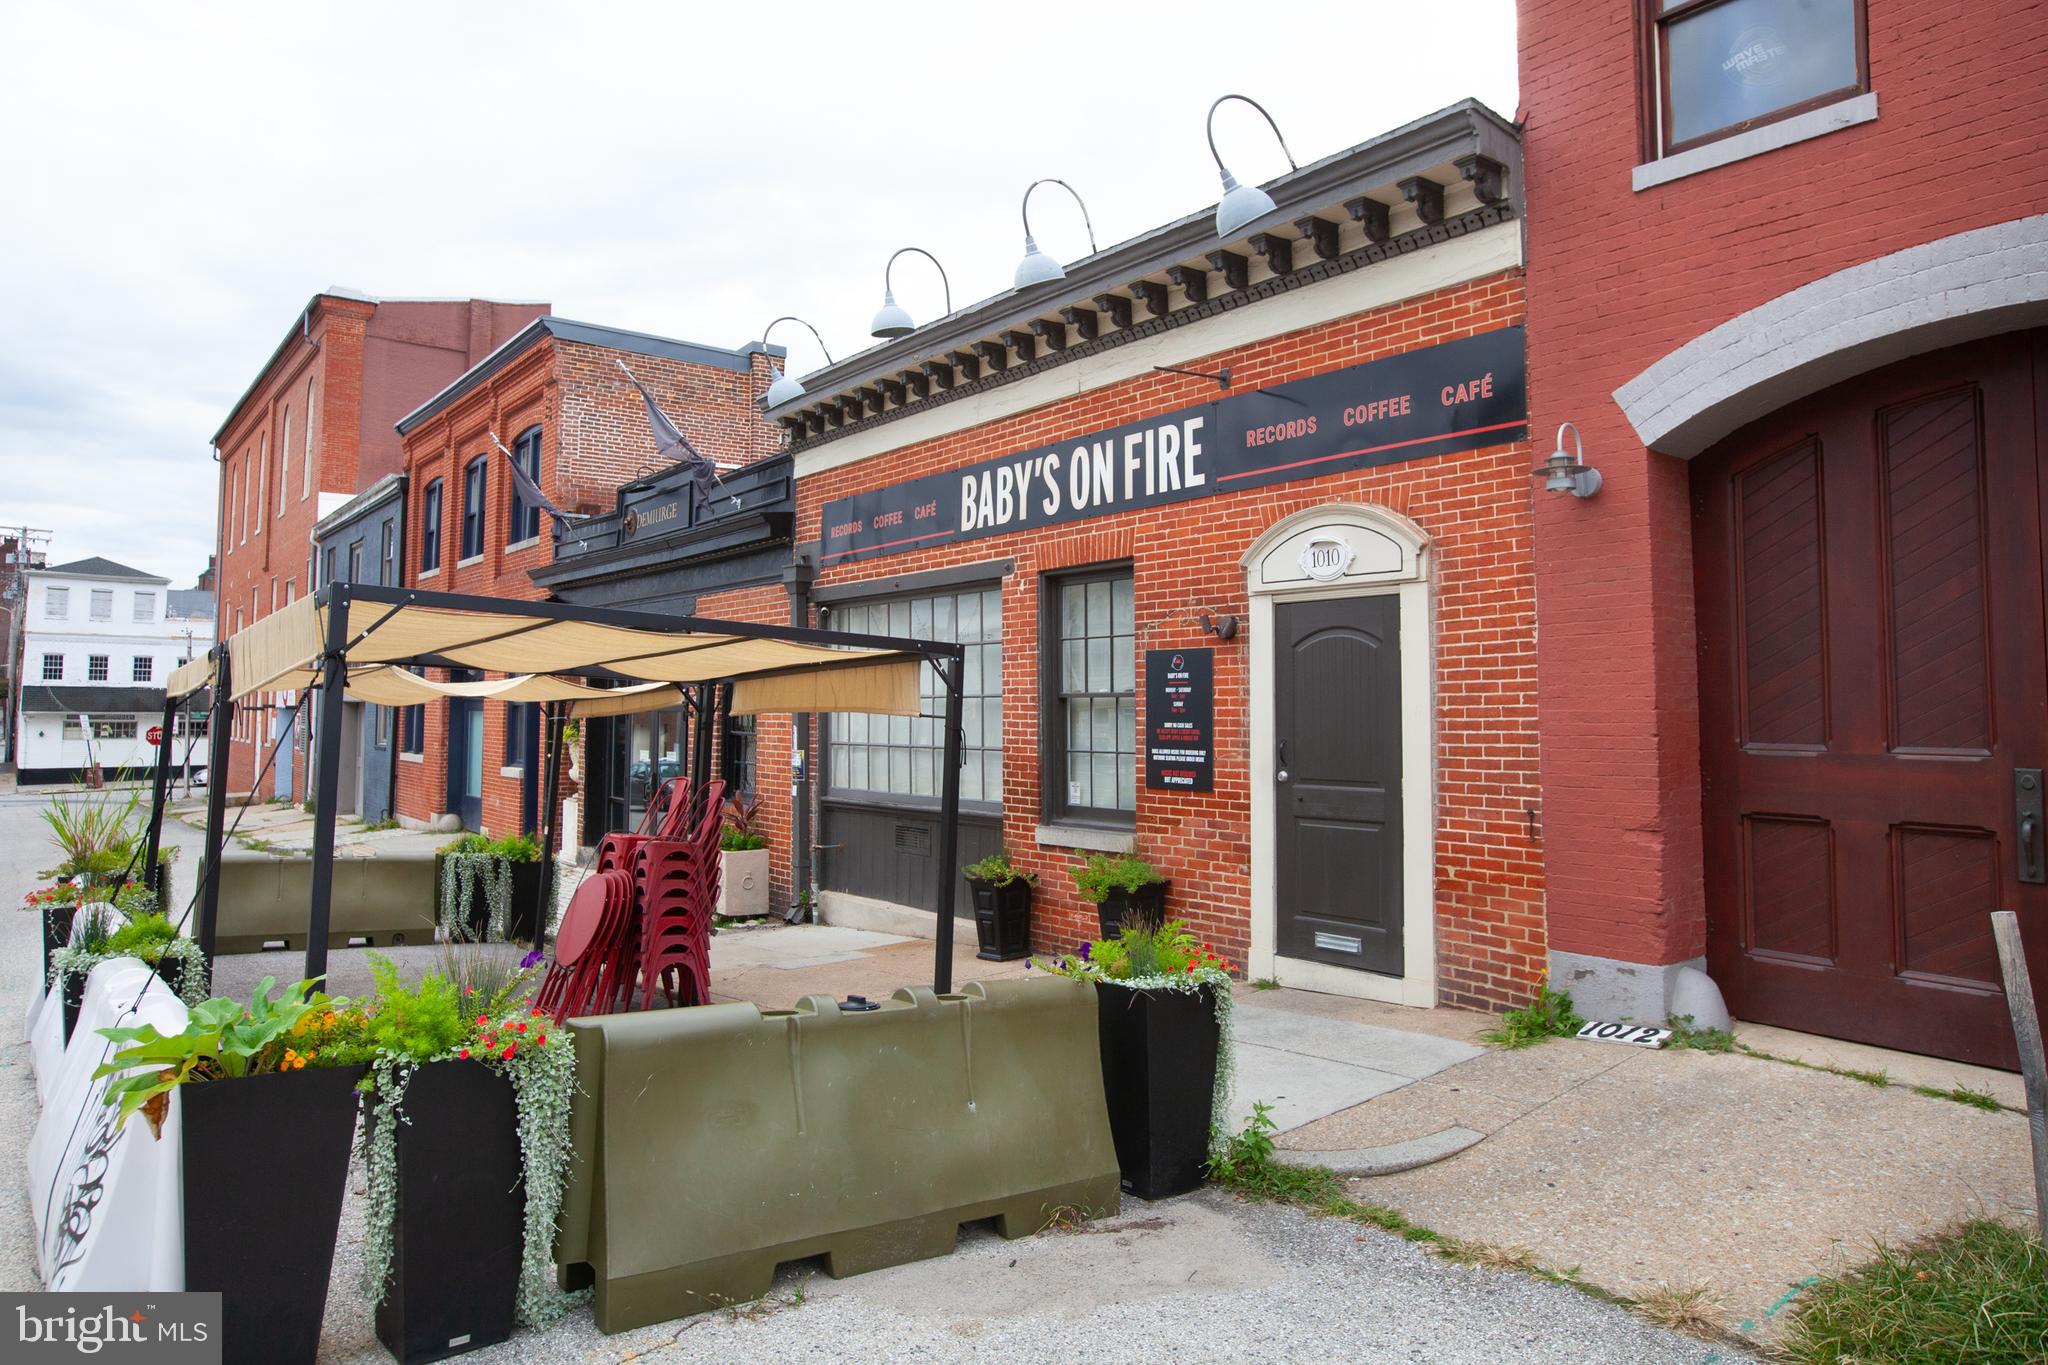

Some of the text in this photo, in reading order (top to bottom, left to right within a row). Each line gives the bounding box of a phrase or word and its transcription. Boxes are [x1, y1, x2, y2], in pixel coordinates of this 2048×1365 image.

[1722, 43, 1761, 70] WAVE
[1246, 372, 1493, 448] RECORDS COFFEE CAFÉ
[960, 416, 1206, 532] BABY'S ON FIRE
[636, 502, 678, 529] DEMIURGE
[830, 500, 937, 539] RECORDS COFFEE CAFÉ
[1311, 548, 1340, 568] 1010
[147, 730, 162, 740] STO
[1580, 1021, 1660, 1043] 1012
